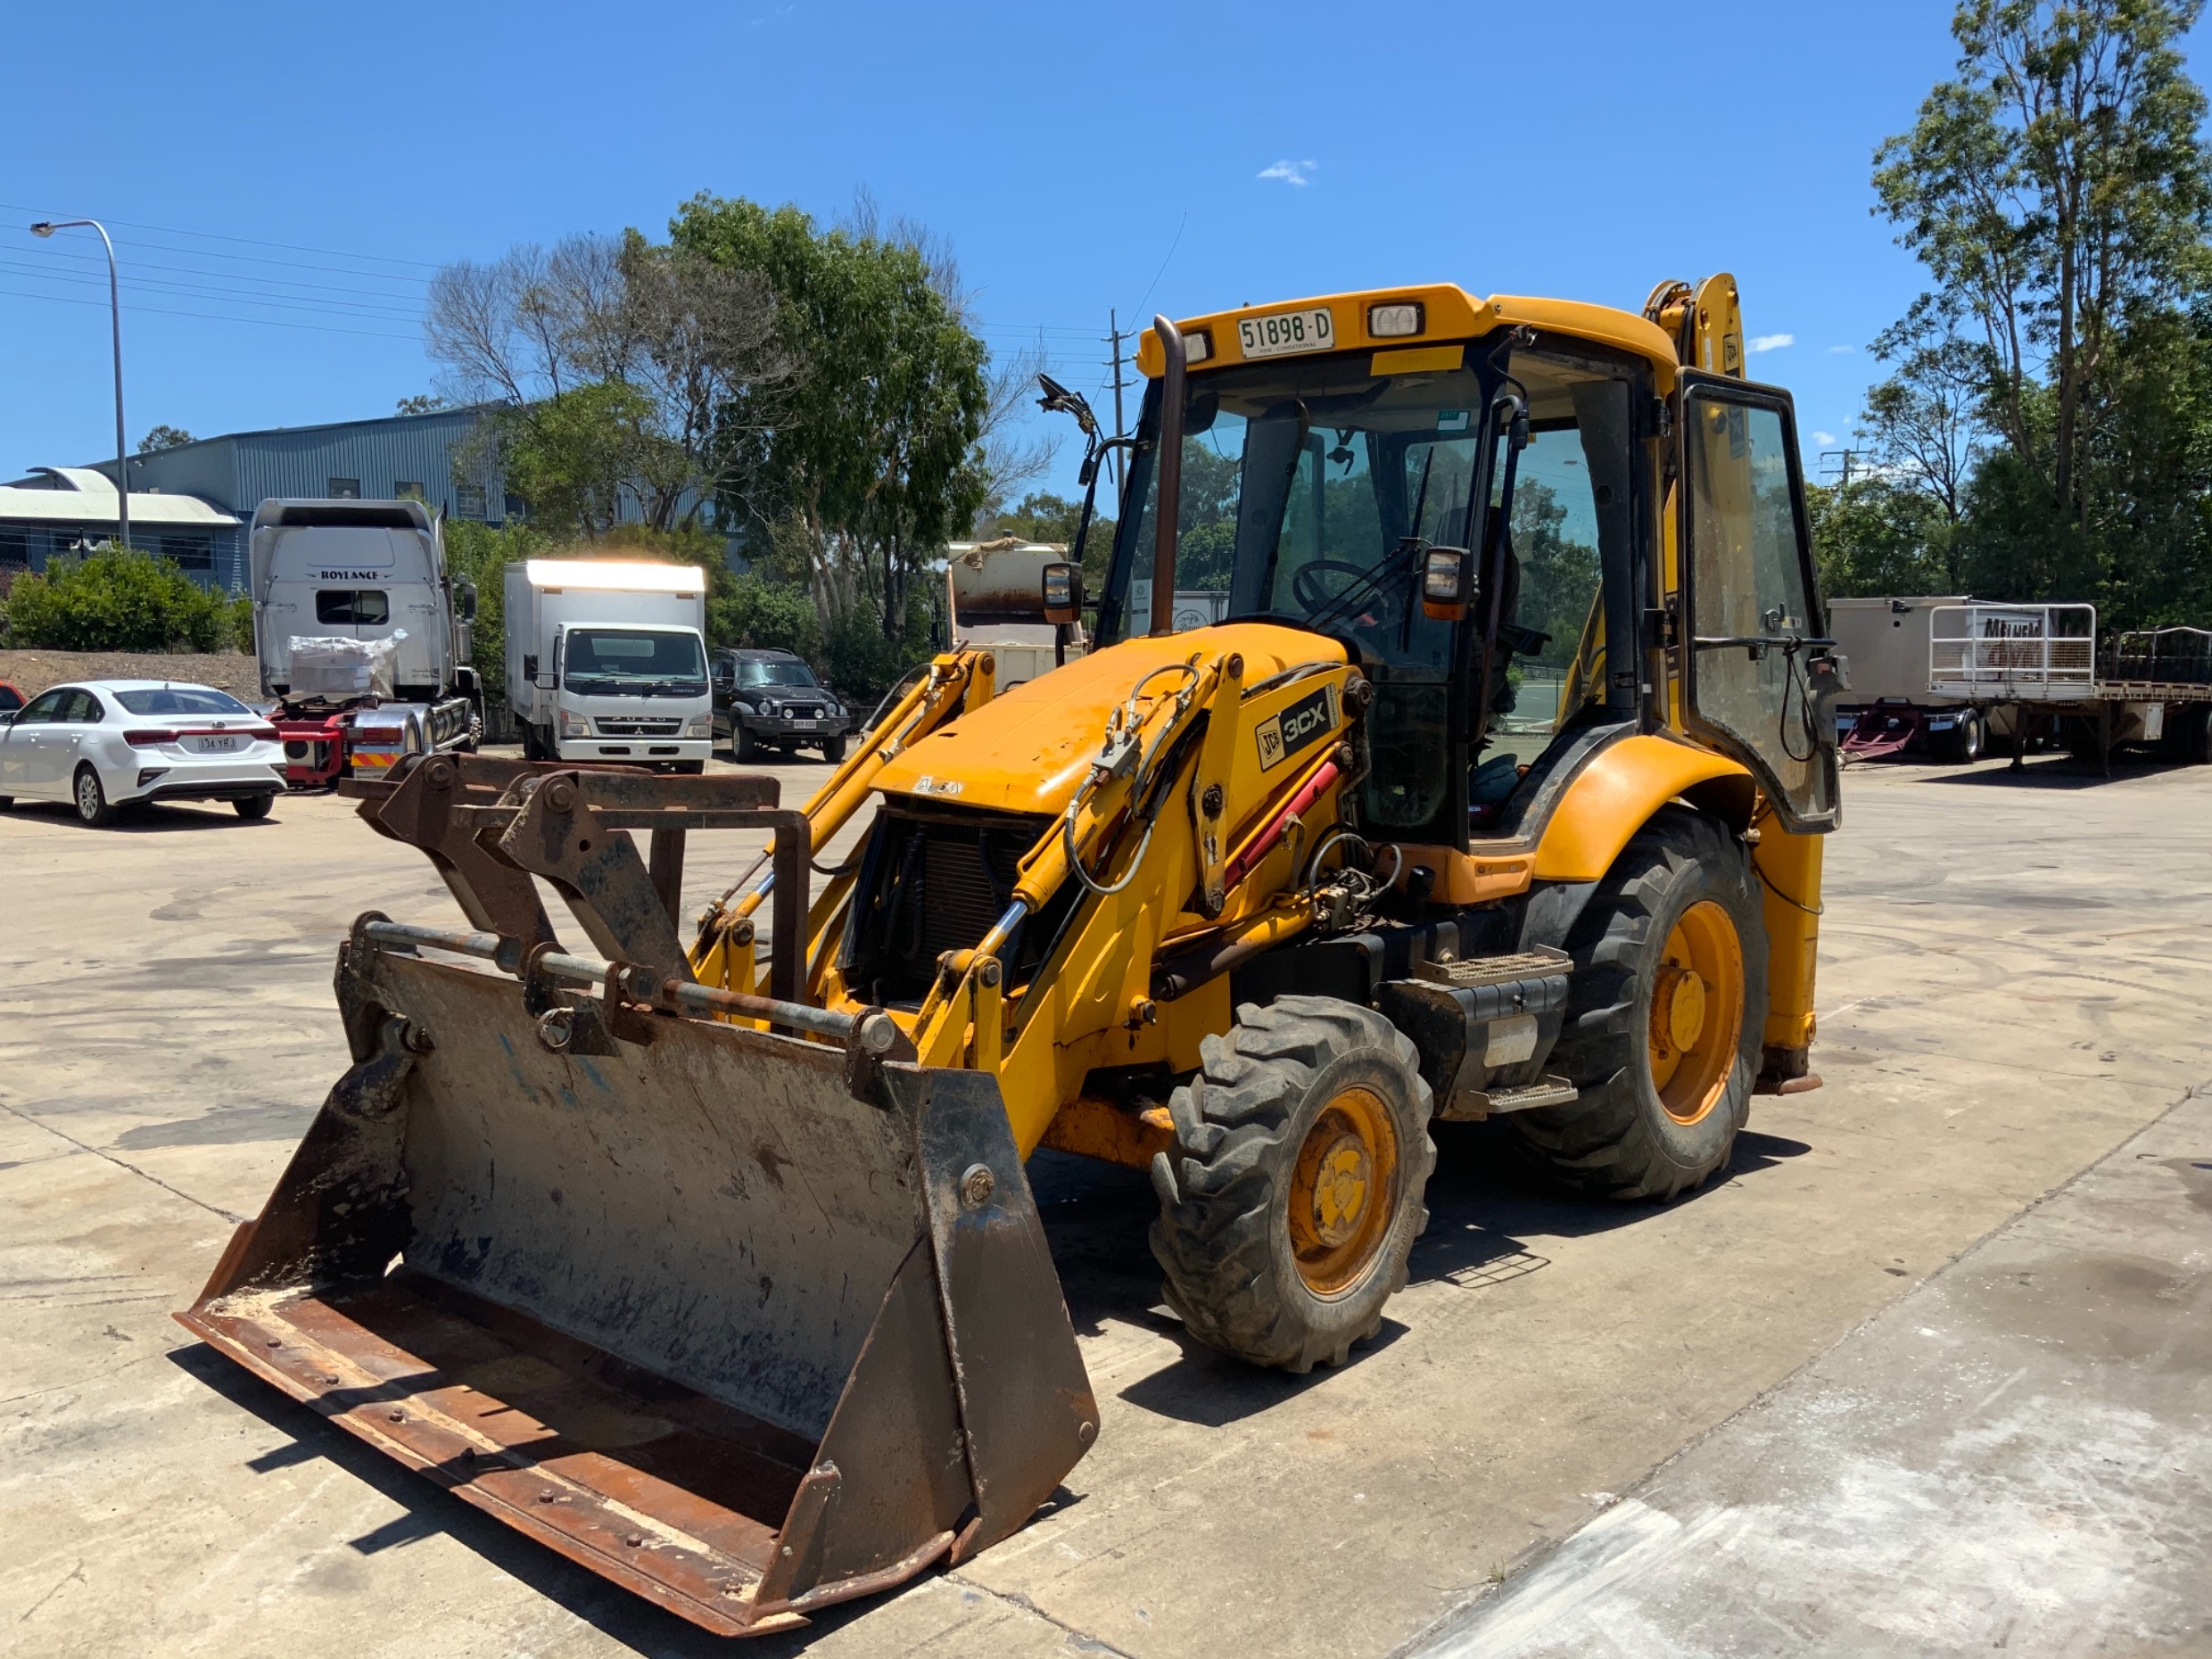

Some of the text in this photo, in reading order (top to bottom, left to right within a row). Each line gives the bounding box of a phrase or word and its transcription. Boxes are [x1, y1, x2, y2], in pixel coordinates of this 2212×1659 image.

[1276, 342, 1316, 352] CONDITIONAL
[321, 571, 378, 580] ROYLANCE
[1283, 701, 1326, 743] 3CX
[218, 738, 235, 748] YRJ
[1263, 731, 1280, 756] JCB
